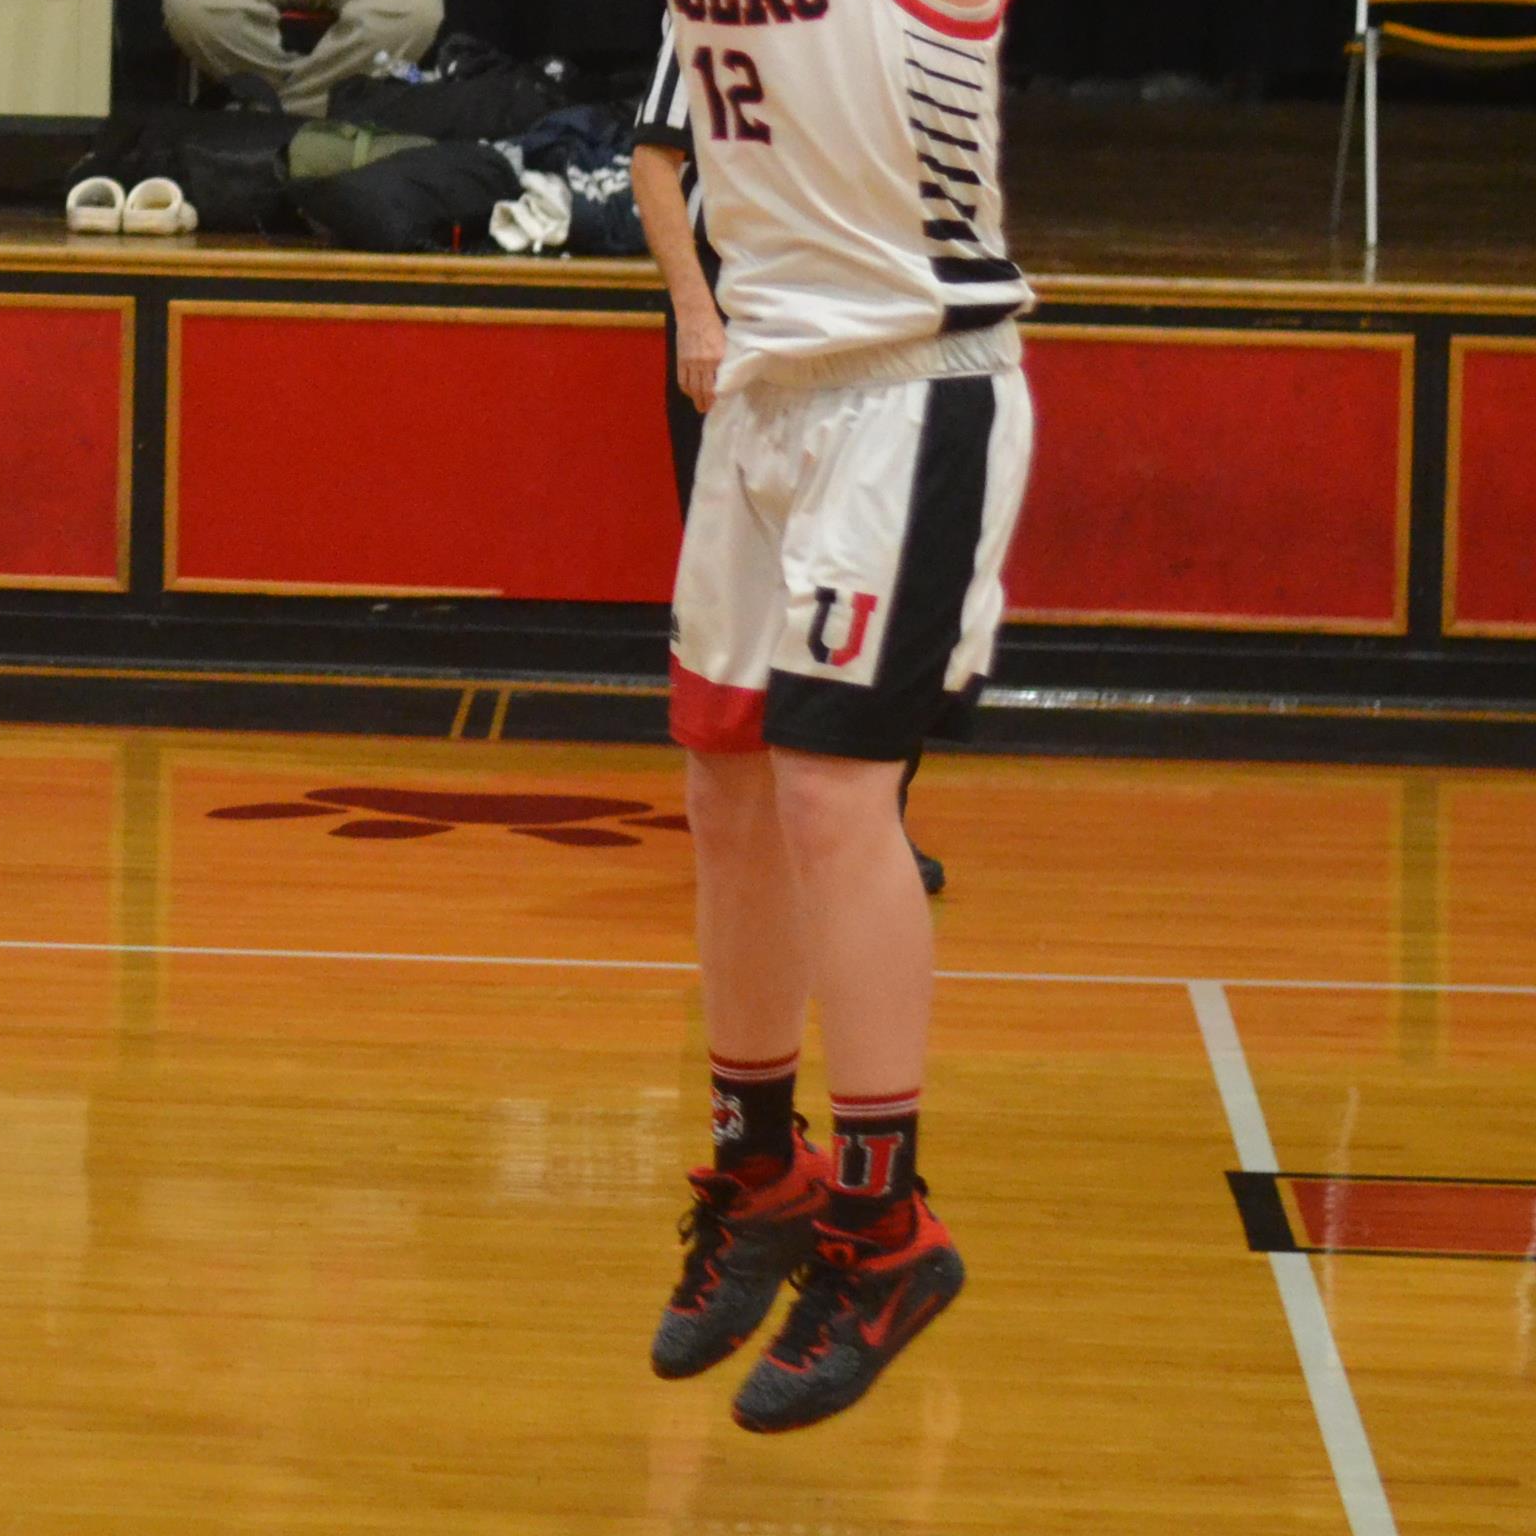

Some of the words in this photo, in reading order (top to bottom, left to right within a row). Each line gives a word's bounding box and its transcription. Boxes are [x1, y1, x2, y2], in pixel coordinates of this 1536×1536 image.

[692, 46, 771, 145] 12
[807, 585, 879, 668] U
[831, 1131, 903, 1198] U
